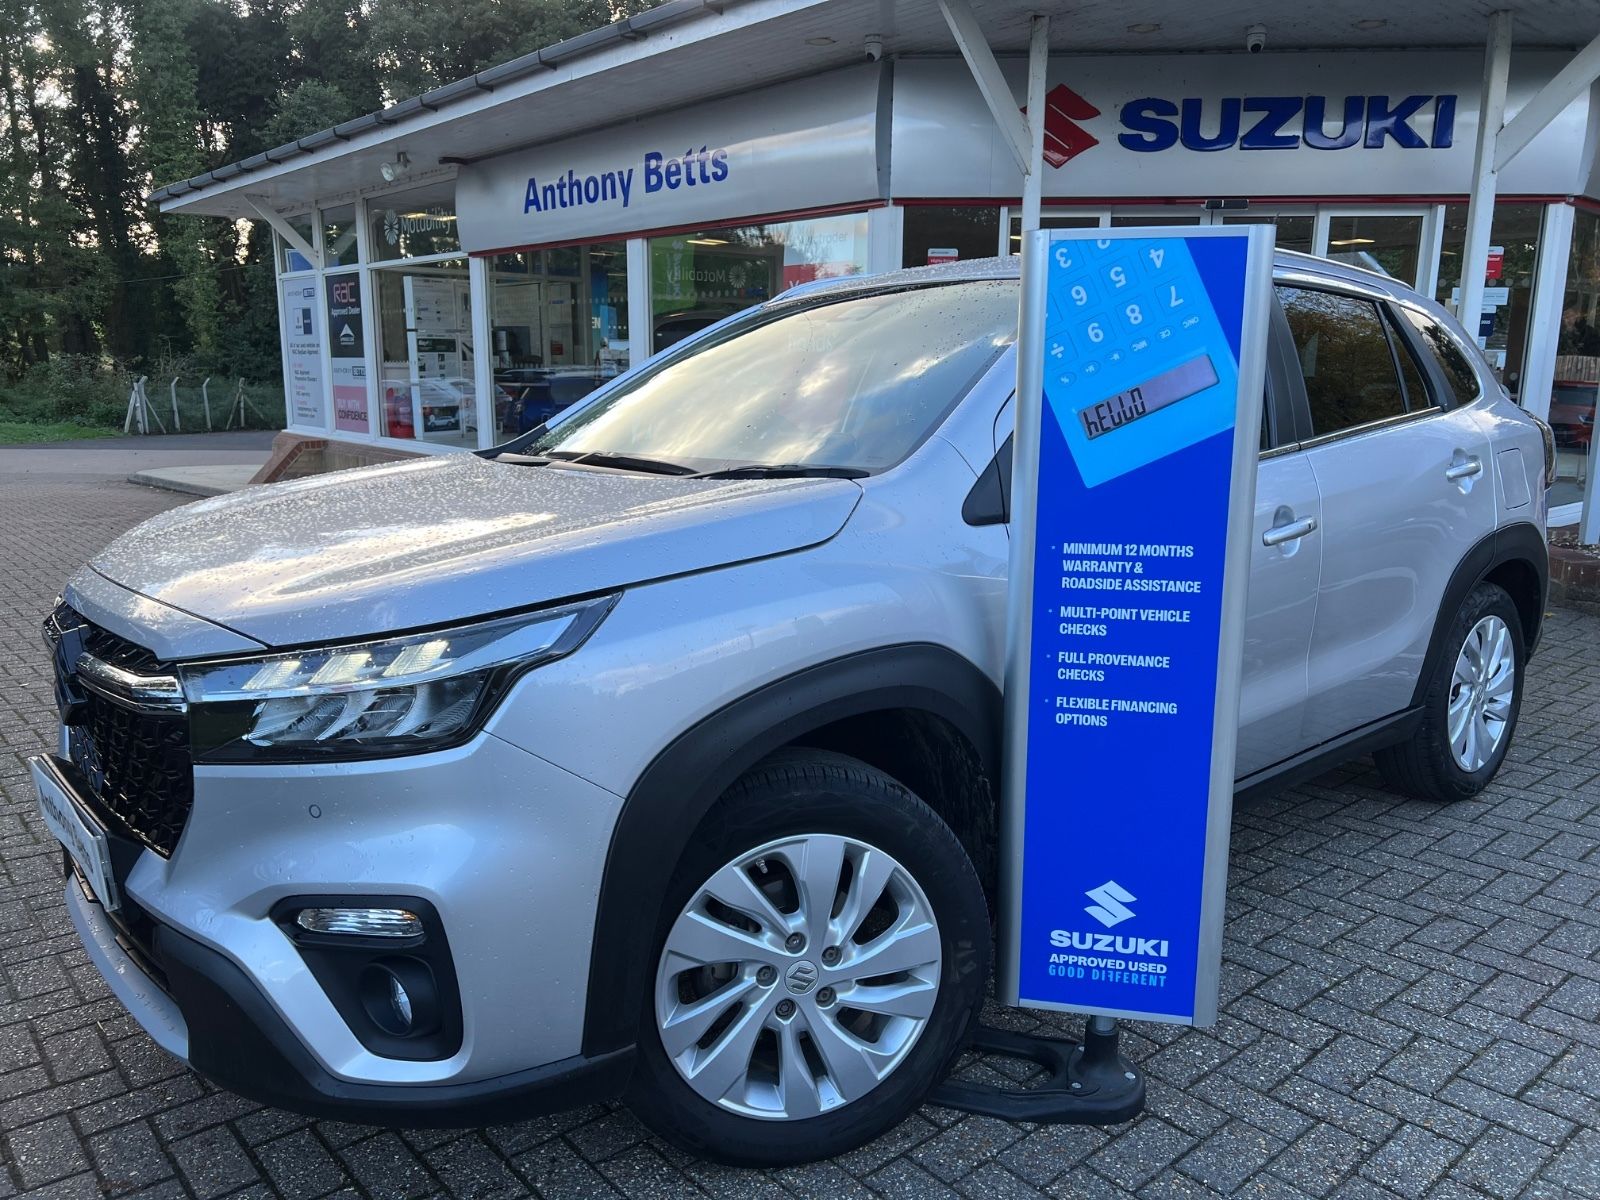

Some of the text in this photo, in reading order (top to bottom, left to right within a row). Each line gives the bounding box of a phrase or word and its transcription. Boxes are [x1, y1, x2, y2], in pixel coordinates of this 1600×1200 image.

[1118, 95, 1457, 152] SUZUKI
[524, 145, 729, 214] Anthony Betts
[1149, 248, 1165, 269] 4
[1110, 266, 1126, 288] 5
[333, 282, 356, 303] RAC
[1170, 285, 1184, 307] 7
[1126, 304, 1143, 325] 8
[1063, 543, 1194, 558] MINIMUM 12 MONTHS
[1062, 560, 1143, 574] WARRANTY &
[1061, 577, 1201, 593] ROADSIDE ASSISTANCE
[1060, 606, 1190, 623] MULTI-POINT VEHICLE
[1059, 623, 1107, 636] CHECKS
[1058, 652, 1170, 668] FULL PROVENANCE
[1057, 668, 1105, 682] CHECKS
[1056, 697, 1178, 714] FLEXIBLE FINANCING
[1055, 713, 1108, 727] OPTIONS
[1050, 929, 1169, 958] SUZUKI
[1049, 953, 1167, 974] APPROVED USED
[1049, 964, 1167, 988] GOOD DIFFERENT
